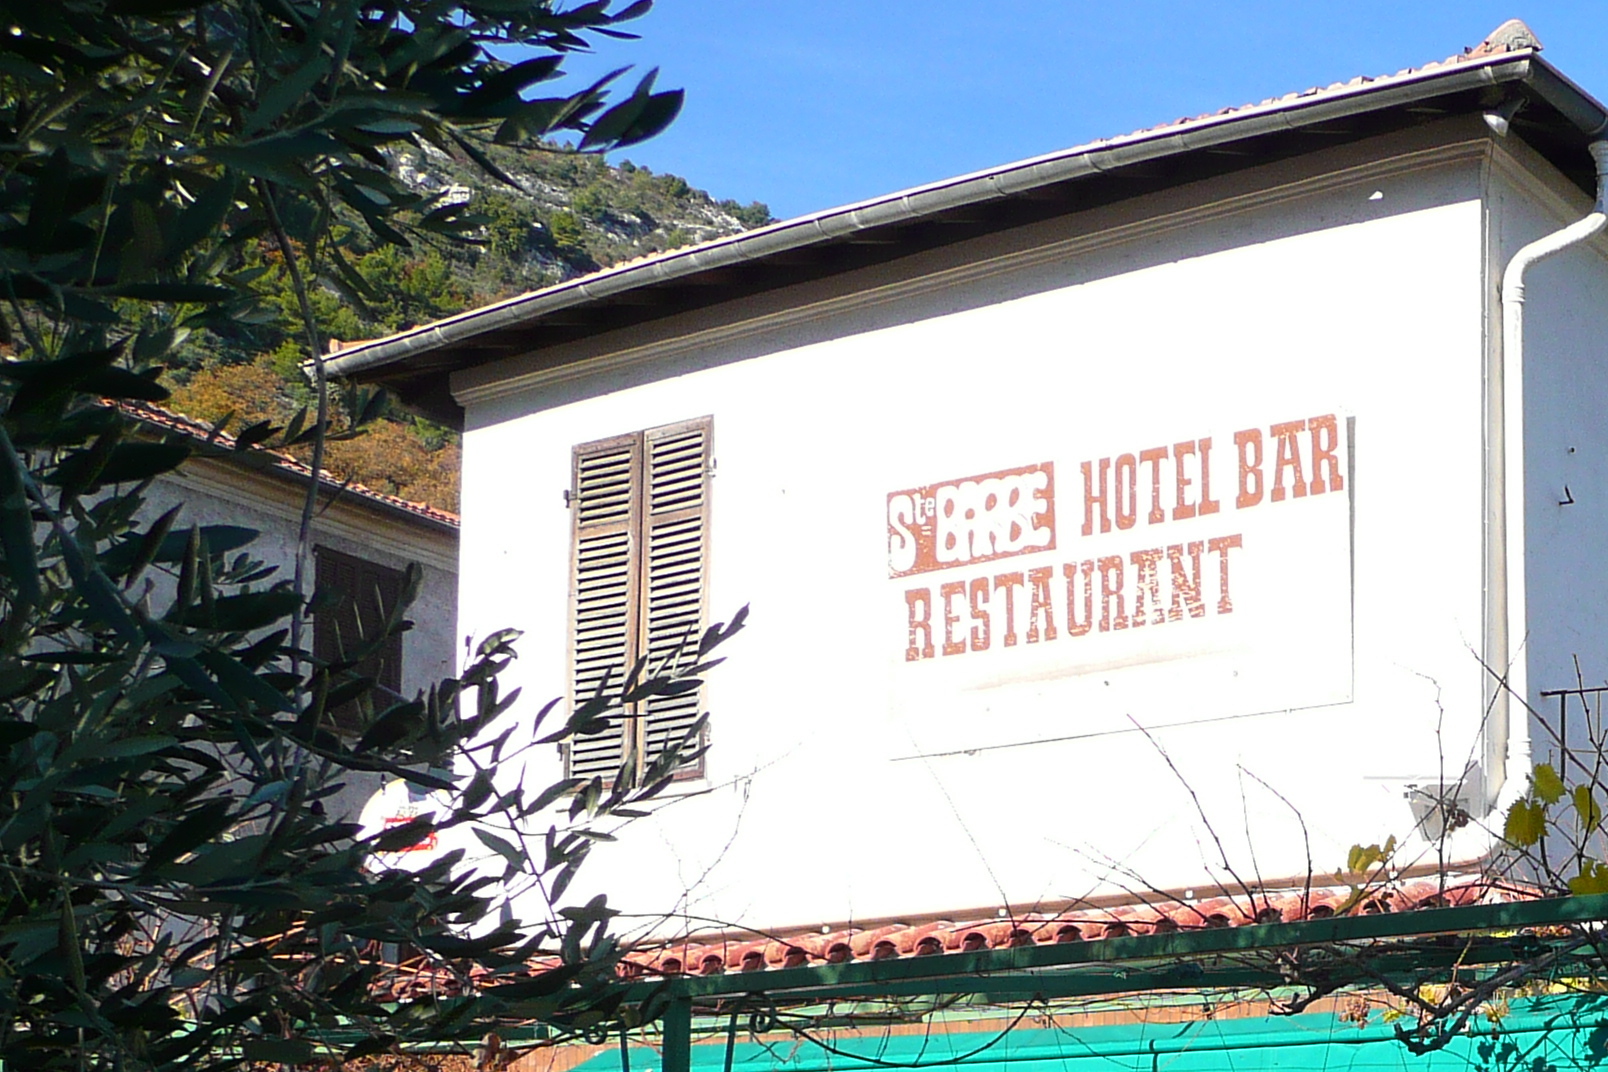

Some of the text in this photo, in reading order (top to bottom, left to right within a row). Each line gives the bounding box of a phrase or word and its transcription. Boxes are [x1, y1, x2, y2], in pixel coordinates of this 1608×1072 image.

[1080, 436, 1221, 537] HOTEL
[1233, 412, 1344, 511] BAR
[903, 533, 1244, 663] RESTAURANT
